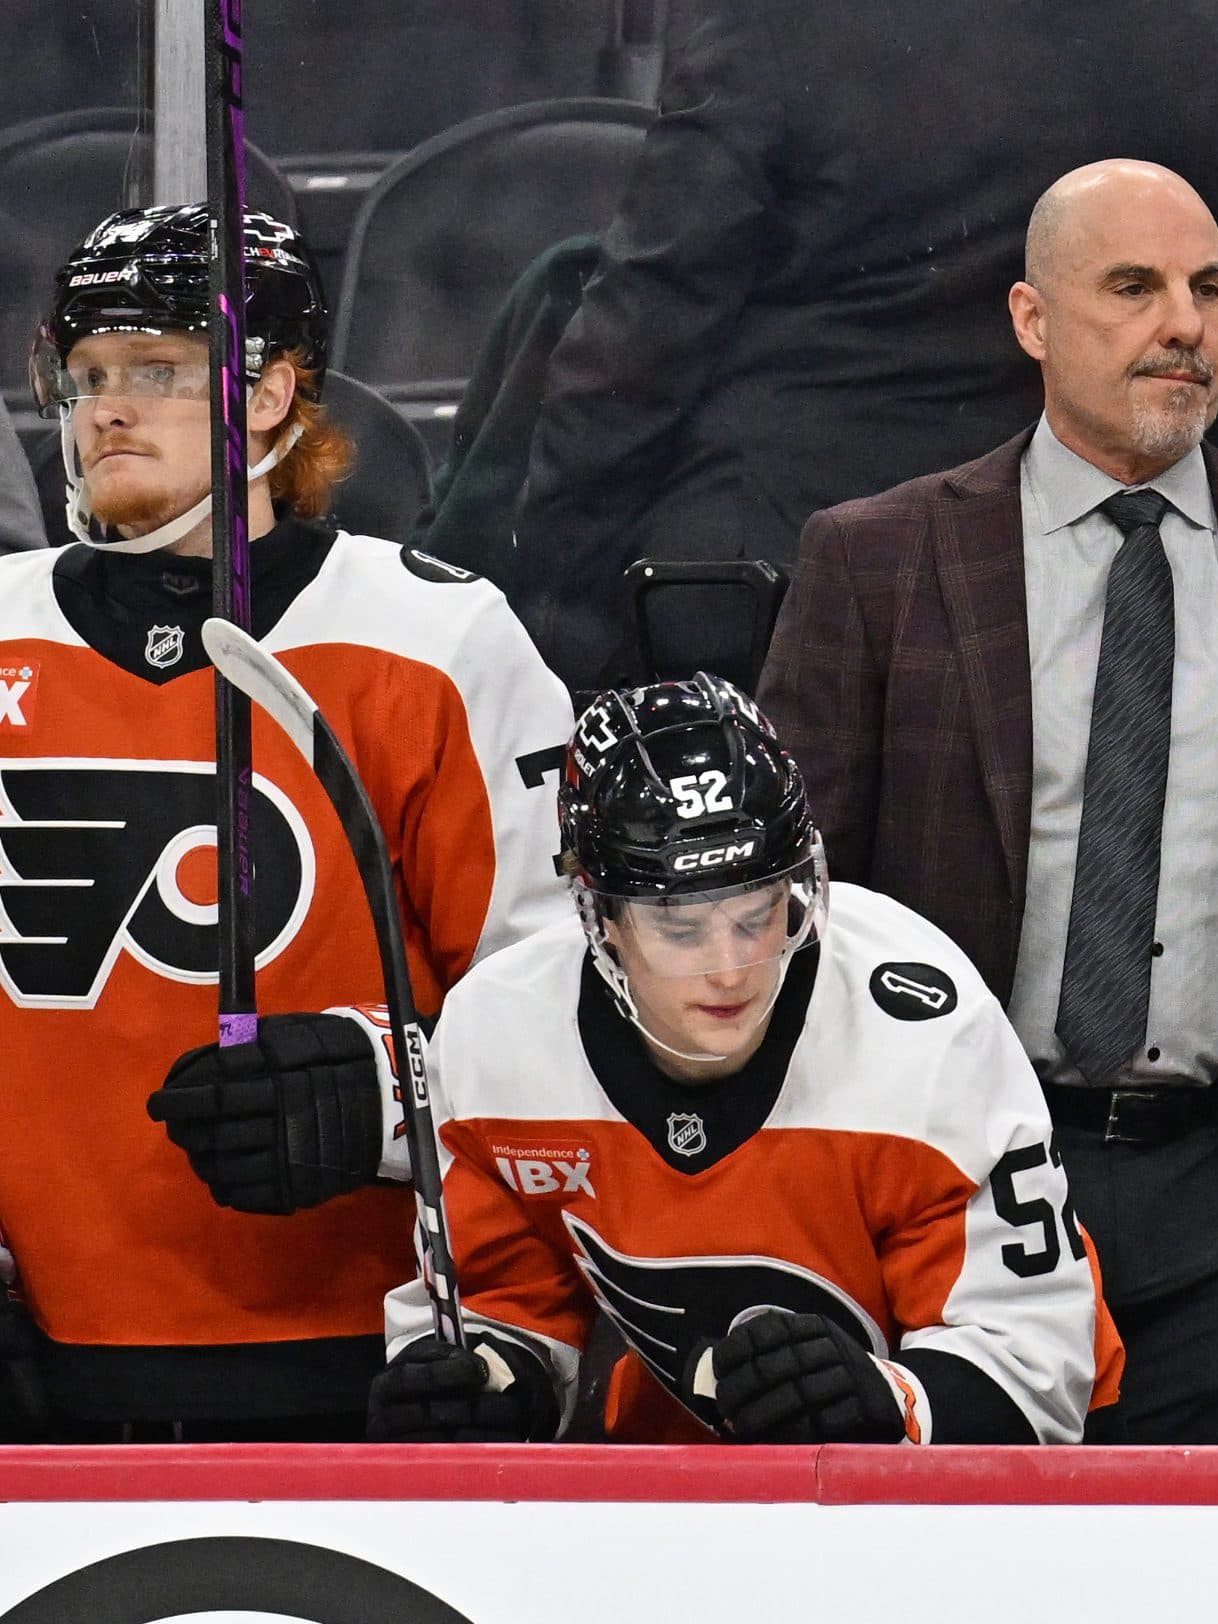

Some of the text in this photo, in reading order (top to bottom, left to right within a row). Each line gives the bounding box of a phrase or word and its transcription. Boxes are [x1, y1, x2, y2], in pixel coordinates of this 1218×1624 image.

[68, 269, 132, 288] BAUER
[669, 769, 734, 819] 52
[673, 841, 755, 872] CCM
[406, 1030, 428, 1101] CCM
[676, 1124, 698, 1146] NHL
[492, 1144, 574, 1160] Independence
[495, 1157, 596, 1199] IBX
